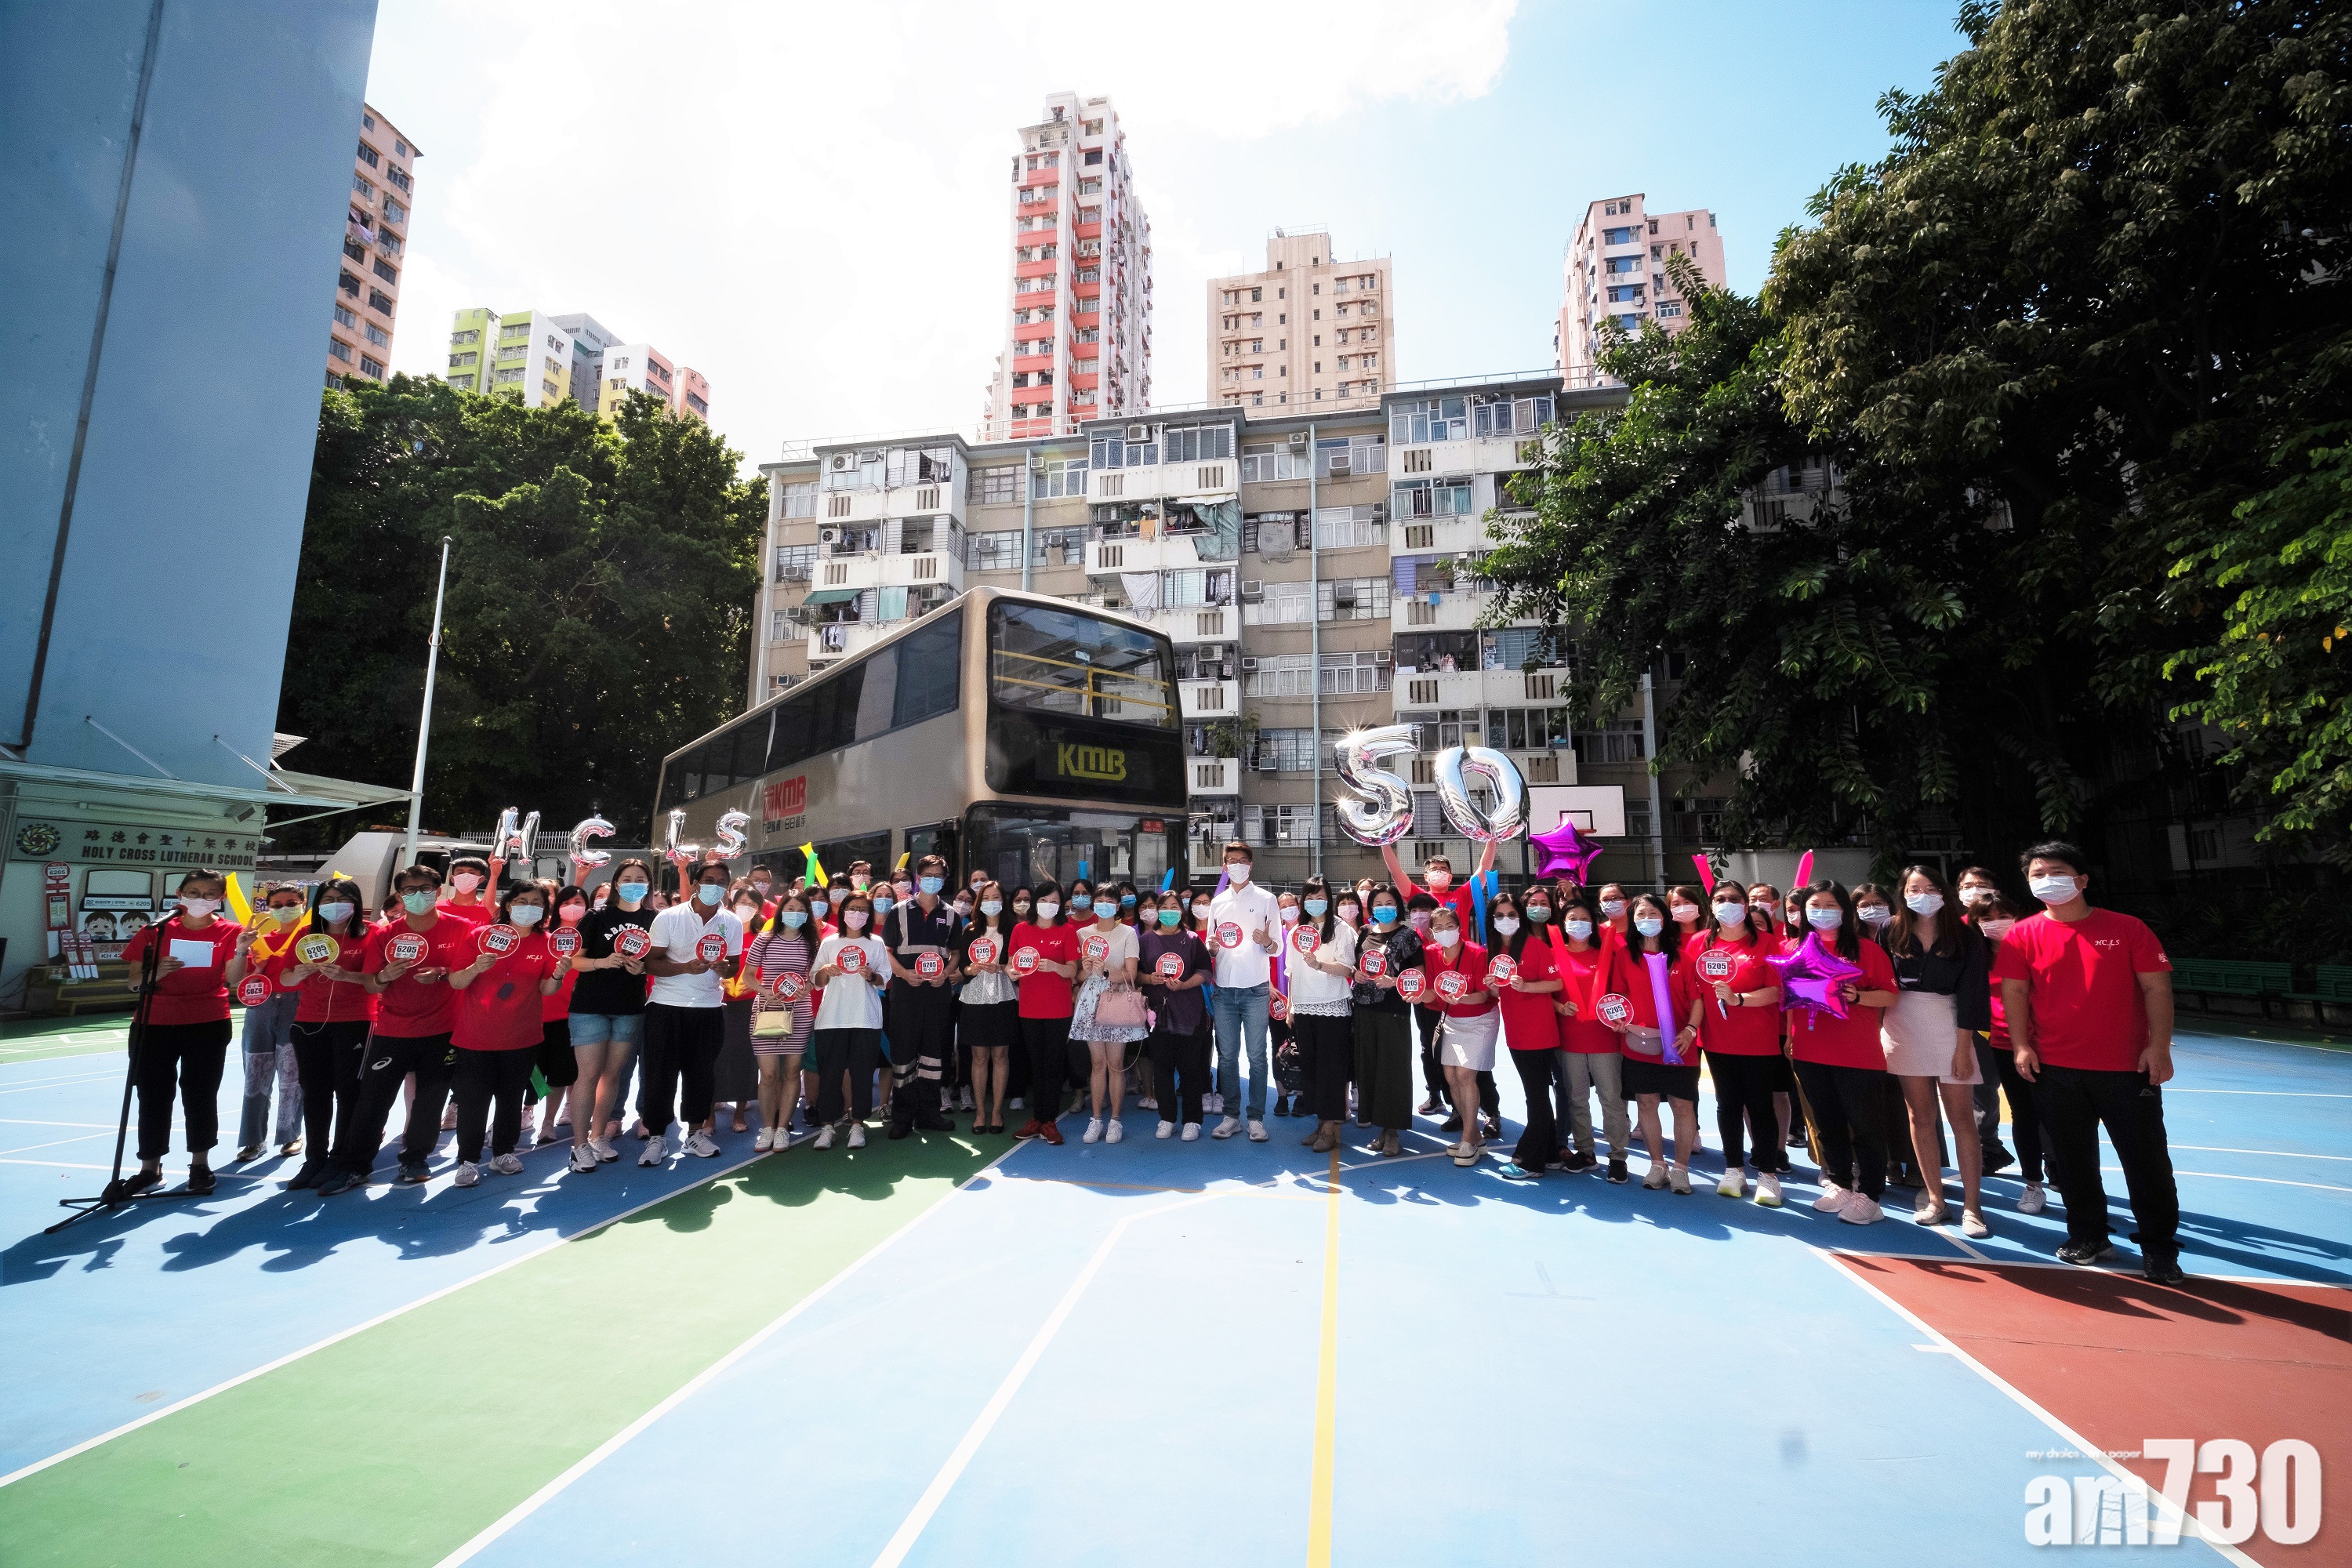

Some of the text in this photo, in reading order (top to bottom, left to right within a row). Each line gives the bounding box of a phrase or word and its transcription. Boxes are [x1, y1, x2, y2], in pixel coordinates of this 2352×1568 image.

[1334, 724, 1530, 847] 50
[84, 829, 256, 851] 路德會聖十架學校
[82, 846, 254, 866] HOLY CROSS LUTHERAN SCHOOL
[490, 935, 510, 946] 6205
[626, 938, 642, 949] 6205
[2095, 939, 2120, 949] HCLS
[306, 944, 327, 954] 6205
[1090, 944, 1102, 953] 6205
[1496, 964, 1508, 974] 6205
[782, 980, 797, 993] 6205
[1443, 980, 1458, 989] 6205
[1606, 1005, 1624, 1014] 6205
